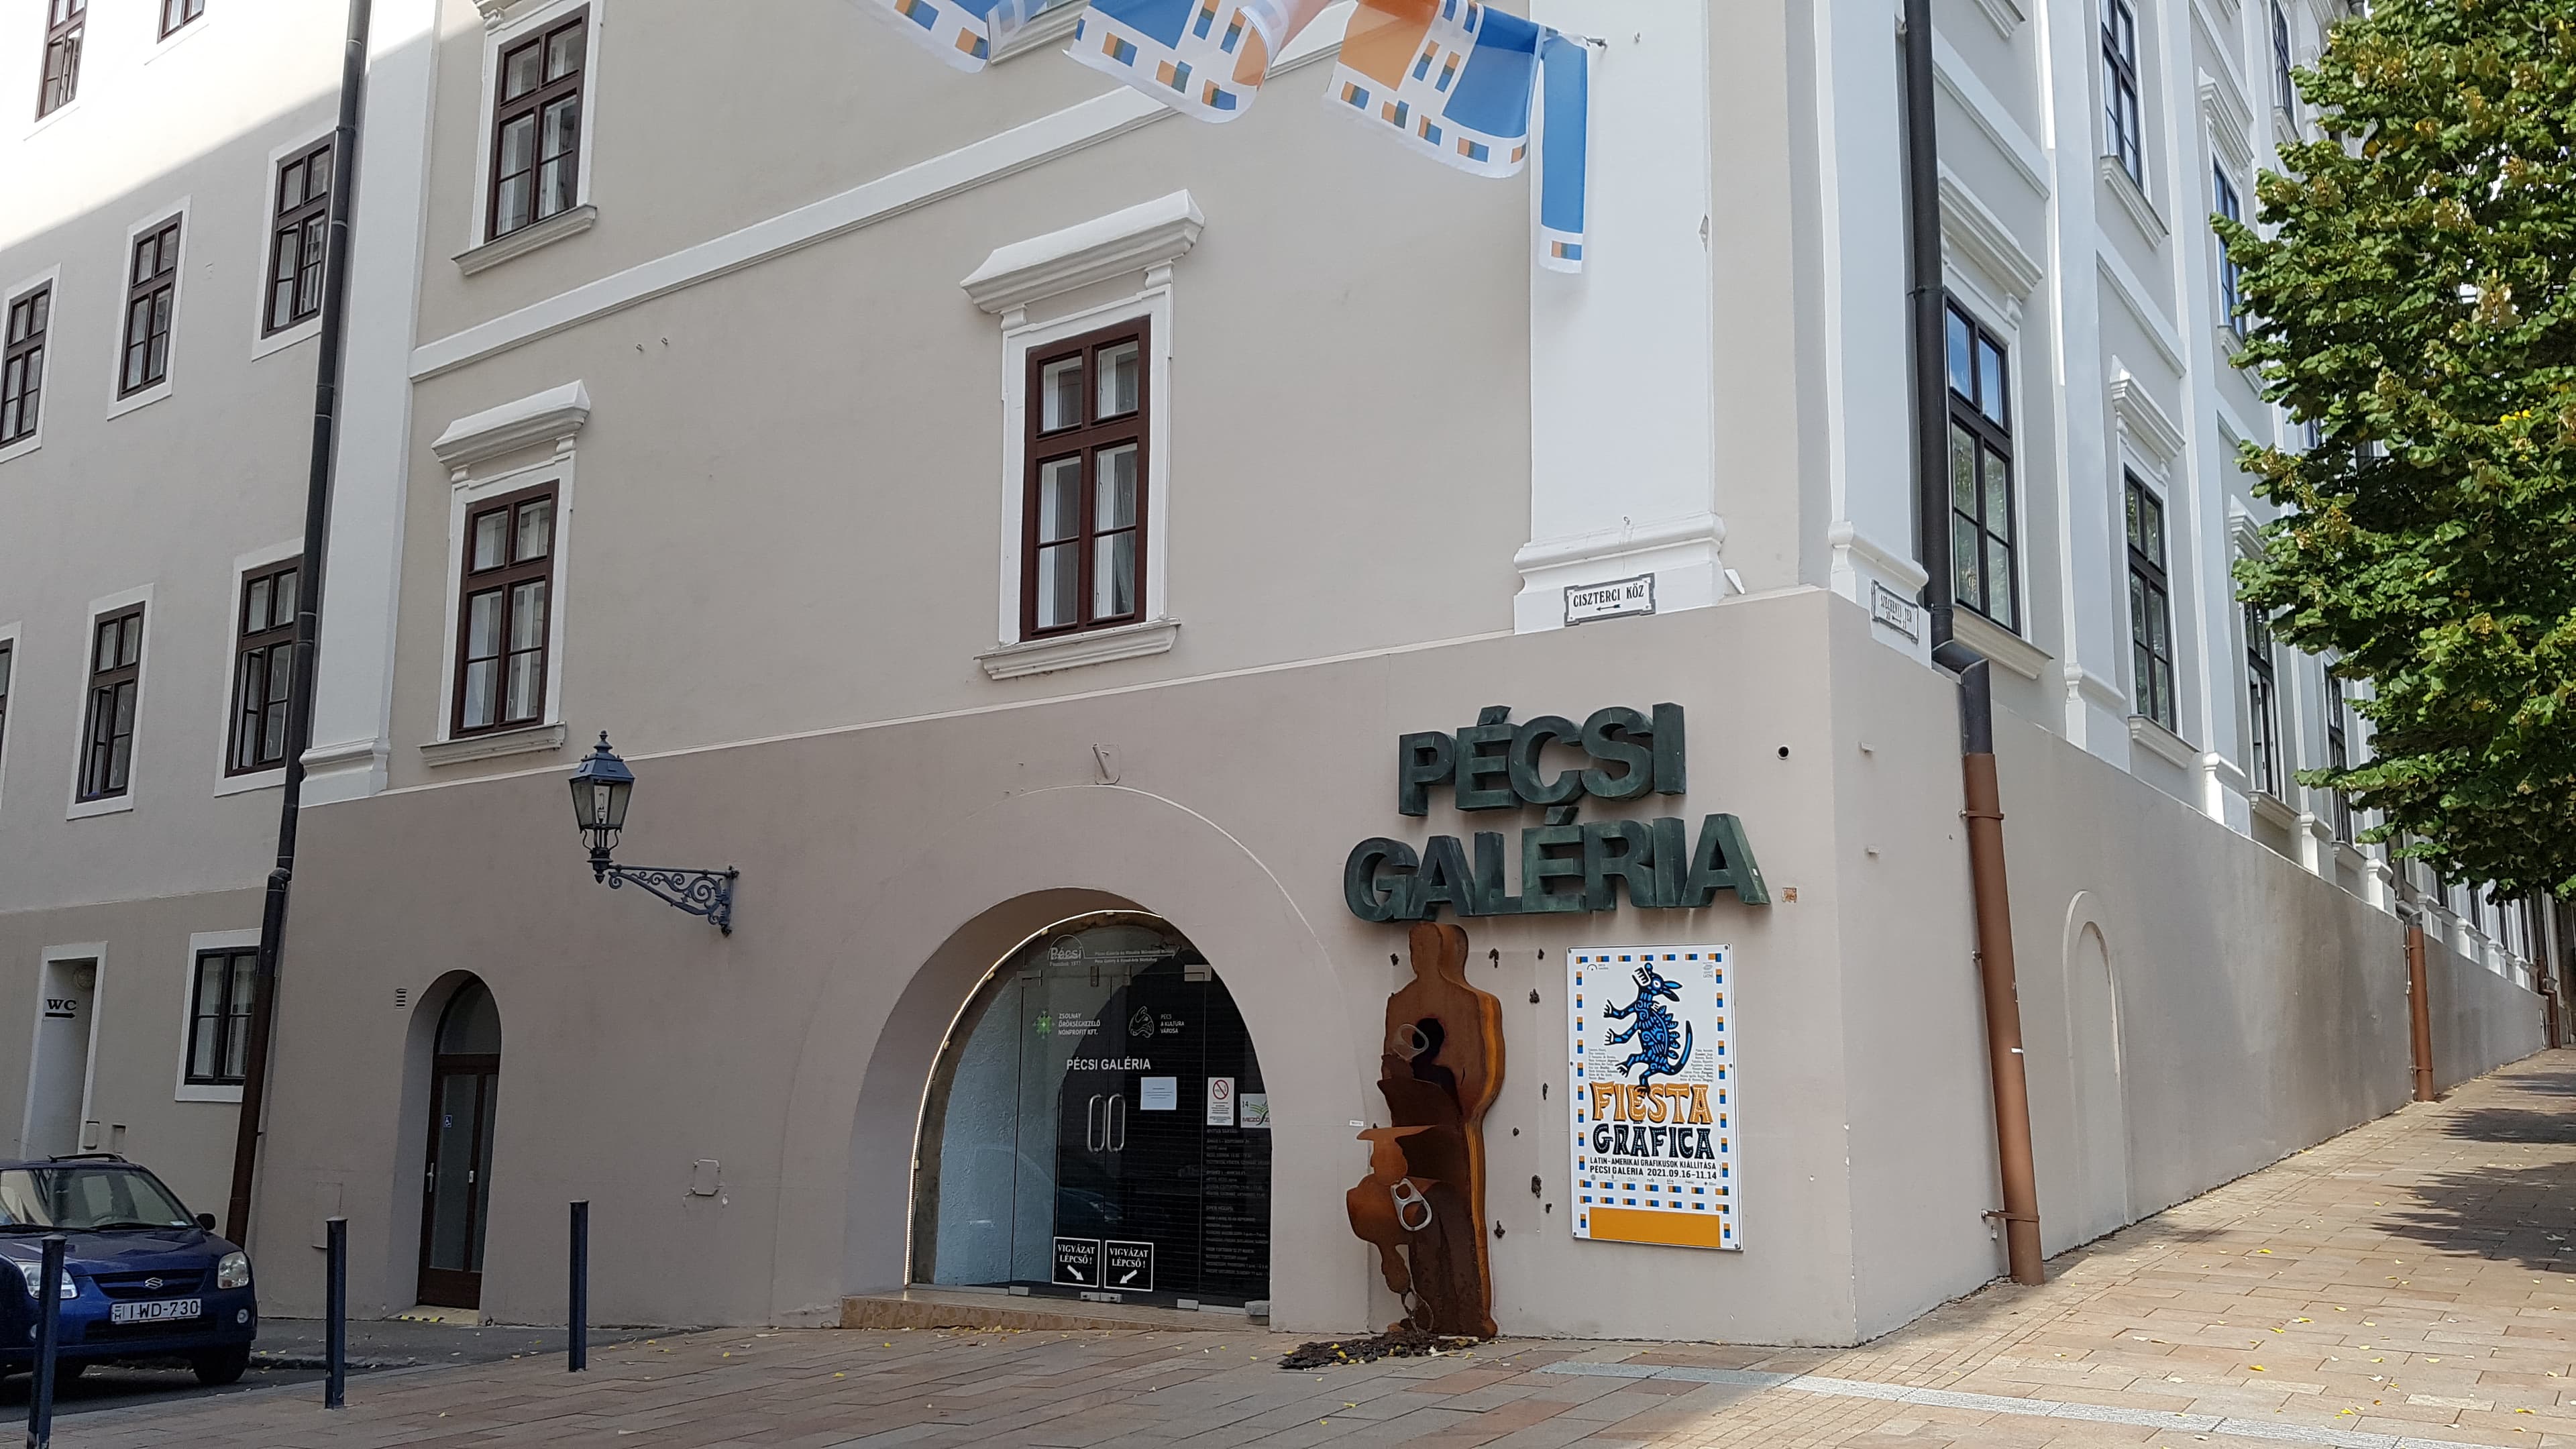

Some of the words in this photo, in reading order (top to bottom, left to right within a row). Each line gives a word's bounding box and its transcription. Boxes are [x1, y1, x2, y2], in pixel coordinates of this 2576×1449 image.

[1573, 588, 1620, 607] CISZTERCI
[1626, 582, 1644, 599] KÖZ
[1399, 702, 1686, 816] PÉCSI
[1344, 806, 1771, 922] GALÉRIA
[47, 999, 76, 1010] WC
[1067, 1057, 1097, 1070] PÉCSI
[1101, 1057, 1151, 1070] GALÉRIA
[1589, 1081, 1713, 1124] FIESTA
[1590, 1157, 1639, 1166] LATIN-AMERIKAI
[1640, 1159, 1678, 1168] GRAFIKUSOK
[1058, 1244, 1095, 1254] VIGYÁZAT
[1110, 1248, 1148, 1257] VIGYÁZAT
[130, 1300, 199, 1319] IWD-730
